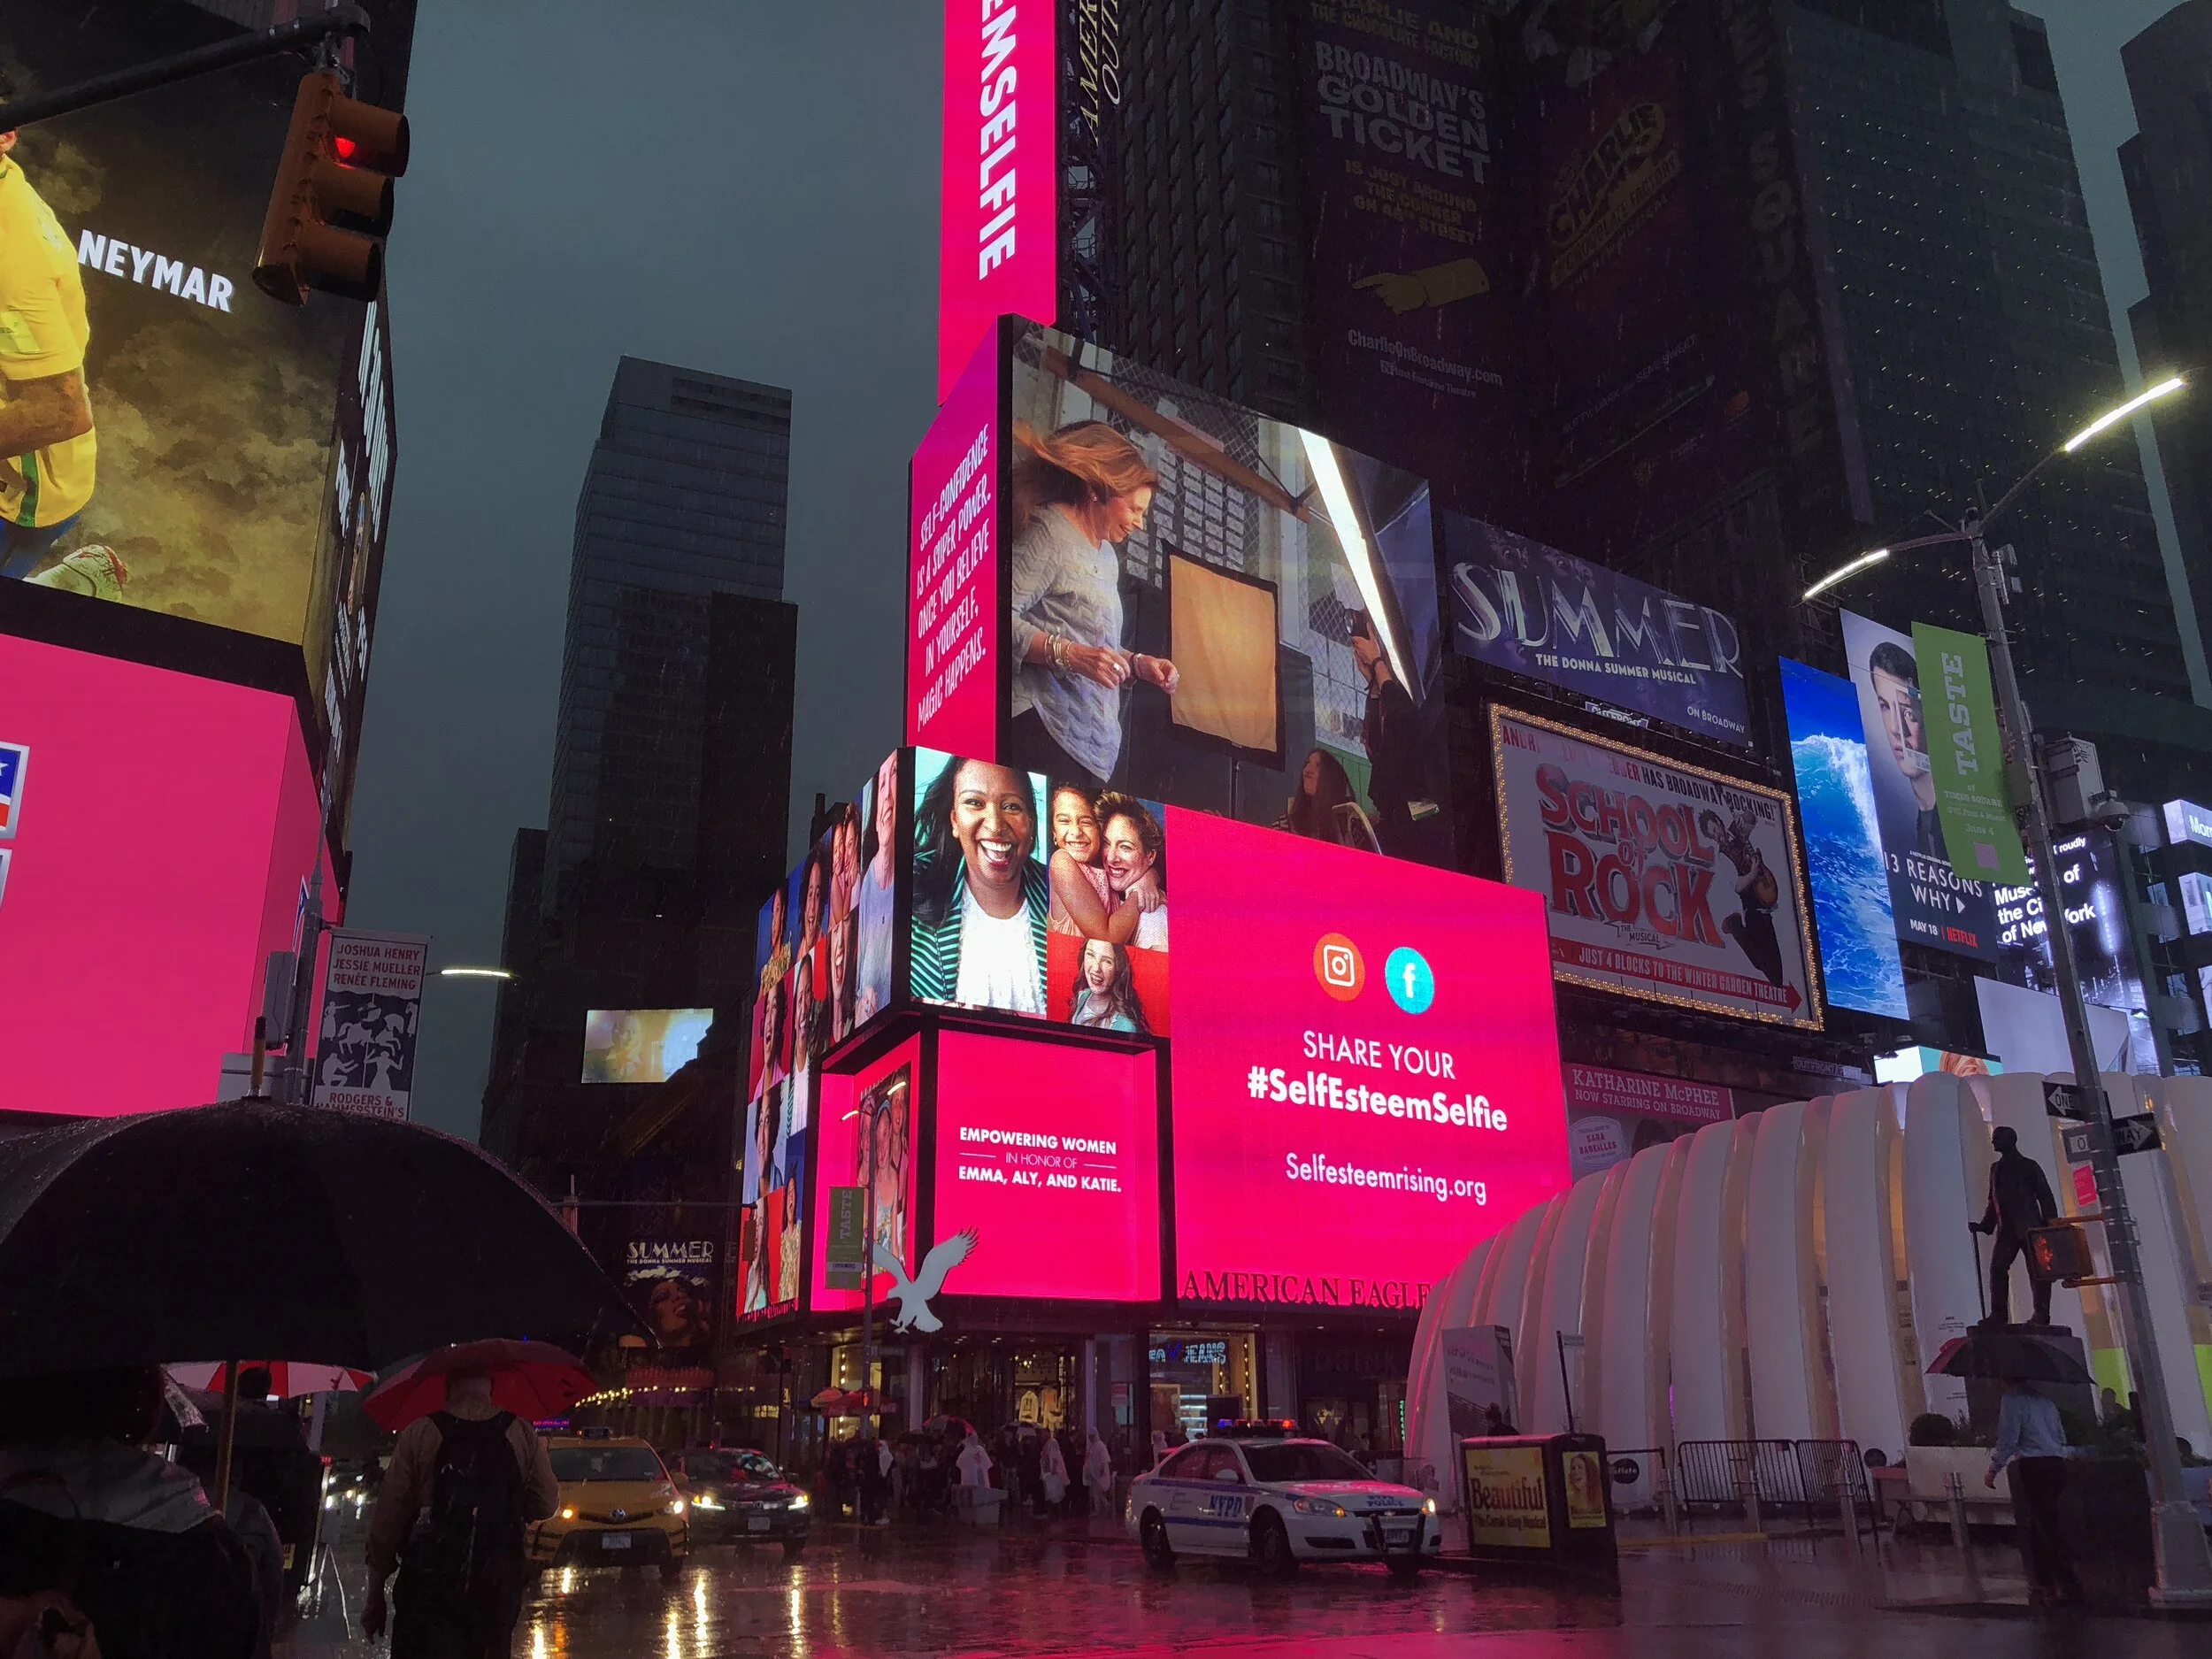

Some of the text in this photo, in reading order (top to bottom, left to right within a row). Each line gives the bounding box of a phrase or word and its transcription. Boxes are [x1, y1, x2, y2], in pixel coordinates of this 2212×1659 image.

[1427, 21, 1480, 50] AND
[1315, 41, 1486, 120] BROADWAY'S
[1317, 74, 1489, 151] GOLDEN
[1319, 105, 1492, 185] TICKET
[77, 228, 233, 313] NEYMAR
[919, 423, 989, 553] SELF-CONFIDENCE
[916, 472, 992, 601] IS A SUPER POWER.
[918, 518, 990, 640] ONCE YOU BELIEVE
[926, 585, 979, 679] IN YOURSELF,
[1451, 562, 1744, 679] SUMMER
[917, 626, 987, 733] MAGIC HAPPENS.
[1535, 653, 1697, 686] THE DONNA SUMMER MUSICAL
[1686, 705, 1746, 734] ON BROADWAY
[1940, 652, 1979, 776] TASTE
[1641, 766, 1664, 789] HAS
[1667, 772, 1724, 806] BROADWAY
[1536, 763, 1717, 865] SCHOOL
[1883, 850, 1900, 873] 13
[2063, 864, 2080, 884] of
[1546, 828, 1725, 949] ROCK
[1911, 882, 1950, 912] WHY
[1997, 896, 2043, 926] the Ci
[1629, 932, 1661, 944] MUSICAL
[1909, 918, 1978, 949] MAY 18 NETFLIX
[2001, 924, 2018, 943] of
[333, 958, 421, 977] JESSIE MUELLER
[336, 943, 420, 961] JOSHUA HENRY
[333, 972, 416, 991] RENÉE FLEMING
[1579, 946, 1603, 965] JUST
[1605, 951, 1613, 968] 4
[1615, 952, 1651, 977] BLOCKS
[1653, 961, 1664, 979] TO
[1666, 964, 1682, 981] THE
[1684, 967, 1718, 990] WINTER
[1718, 973, 1752, 996] GARDEN
[1753, 980, 1787, 1003] THEATRE
[1302, 1030, 1456, 1080] SHARE YOUR
[329, 1093, 394, 1106] RODGERS &
[1248, 1065, 1508, 1132] #SelfEsteemSelfie
[1571, 1068, 1720, 1107] KATHARINE McPHEE
[1575, 1090, 1721, 1120] NOW STARRING ON BROADWAY
[959, 1126, 1117, 1155] EMPOWERING WOMEN
[1005, 1152, 1077, 1169] IN HONOR OF
[958, 1166, 1122, 1193] EMMA, ALY, AND KATIE.
[1286, 1152, 1486, 1206] Selfesteemrising.org
[626, 1240, 714, 1259] SUMMER
[1181, 1270, 1432, 1310] AMERICAN EAGLE
[1184, 1341, 1226, 1364] JEANS
[1210, 1495, 1242, 1517] NYPD
[1469, 1476, 1544, 1510] Beautiful
